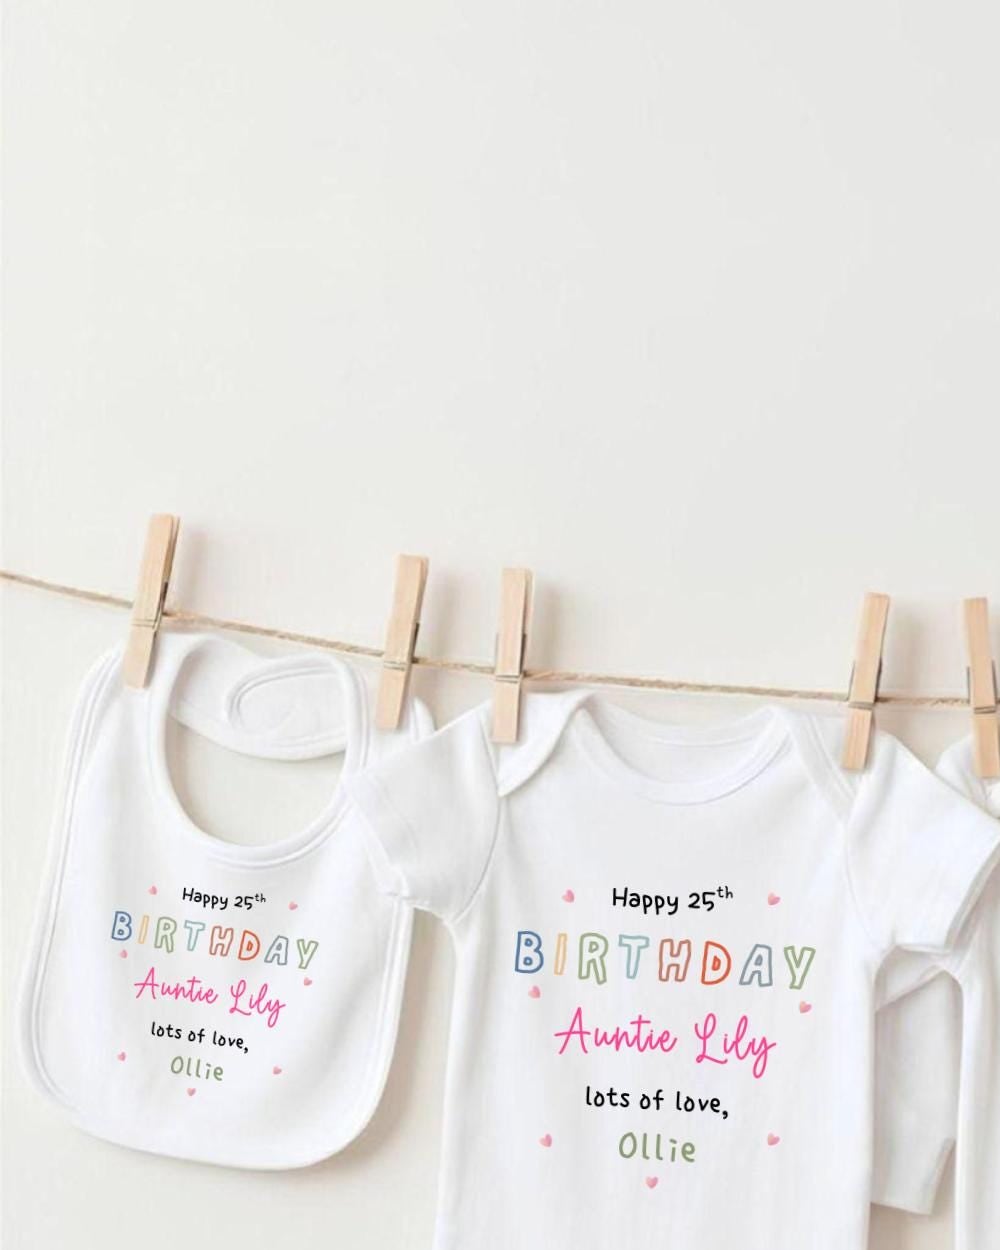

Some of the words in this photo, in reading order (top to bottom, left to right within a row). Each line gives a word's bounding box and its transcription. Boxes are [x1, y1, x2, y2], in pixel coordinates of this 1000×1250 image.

[182, 887, 228, 910] Happy
[234, 893, 266, 910] 25th
[612, 887, 678, 916] Happy
[688, 885, 733, 912] 25th
[111, 911, 319, 969] BIRTHDAY
[514, 929, 816, 990] BIRTHDAY
[134, 967, 219, 1004] Auntie
[229, 978, 286, 1028] Lily
[151, 1021, 182, 1039] lots
[188, 1028, 205, 1044] of
[213, 1030, 248, 1054] love,
[554, 1007, 678, 1055] Auntie
[694, 1013, 777, 1079] Lily
[171, 1056, 223, 1081] Ollie
[586, 1085, 630, 1108] lots
[639, 1089, 664, 1111] of
[676, 1091, 728, 1120] love,
[619, 1132, 695, 1163] Ollie
